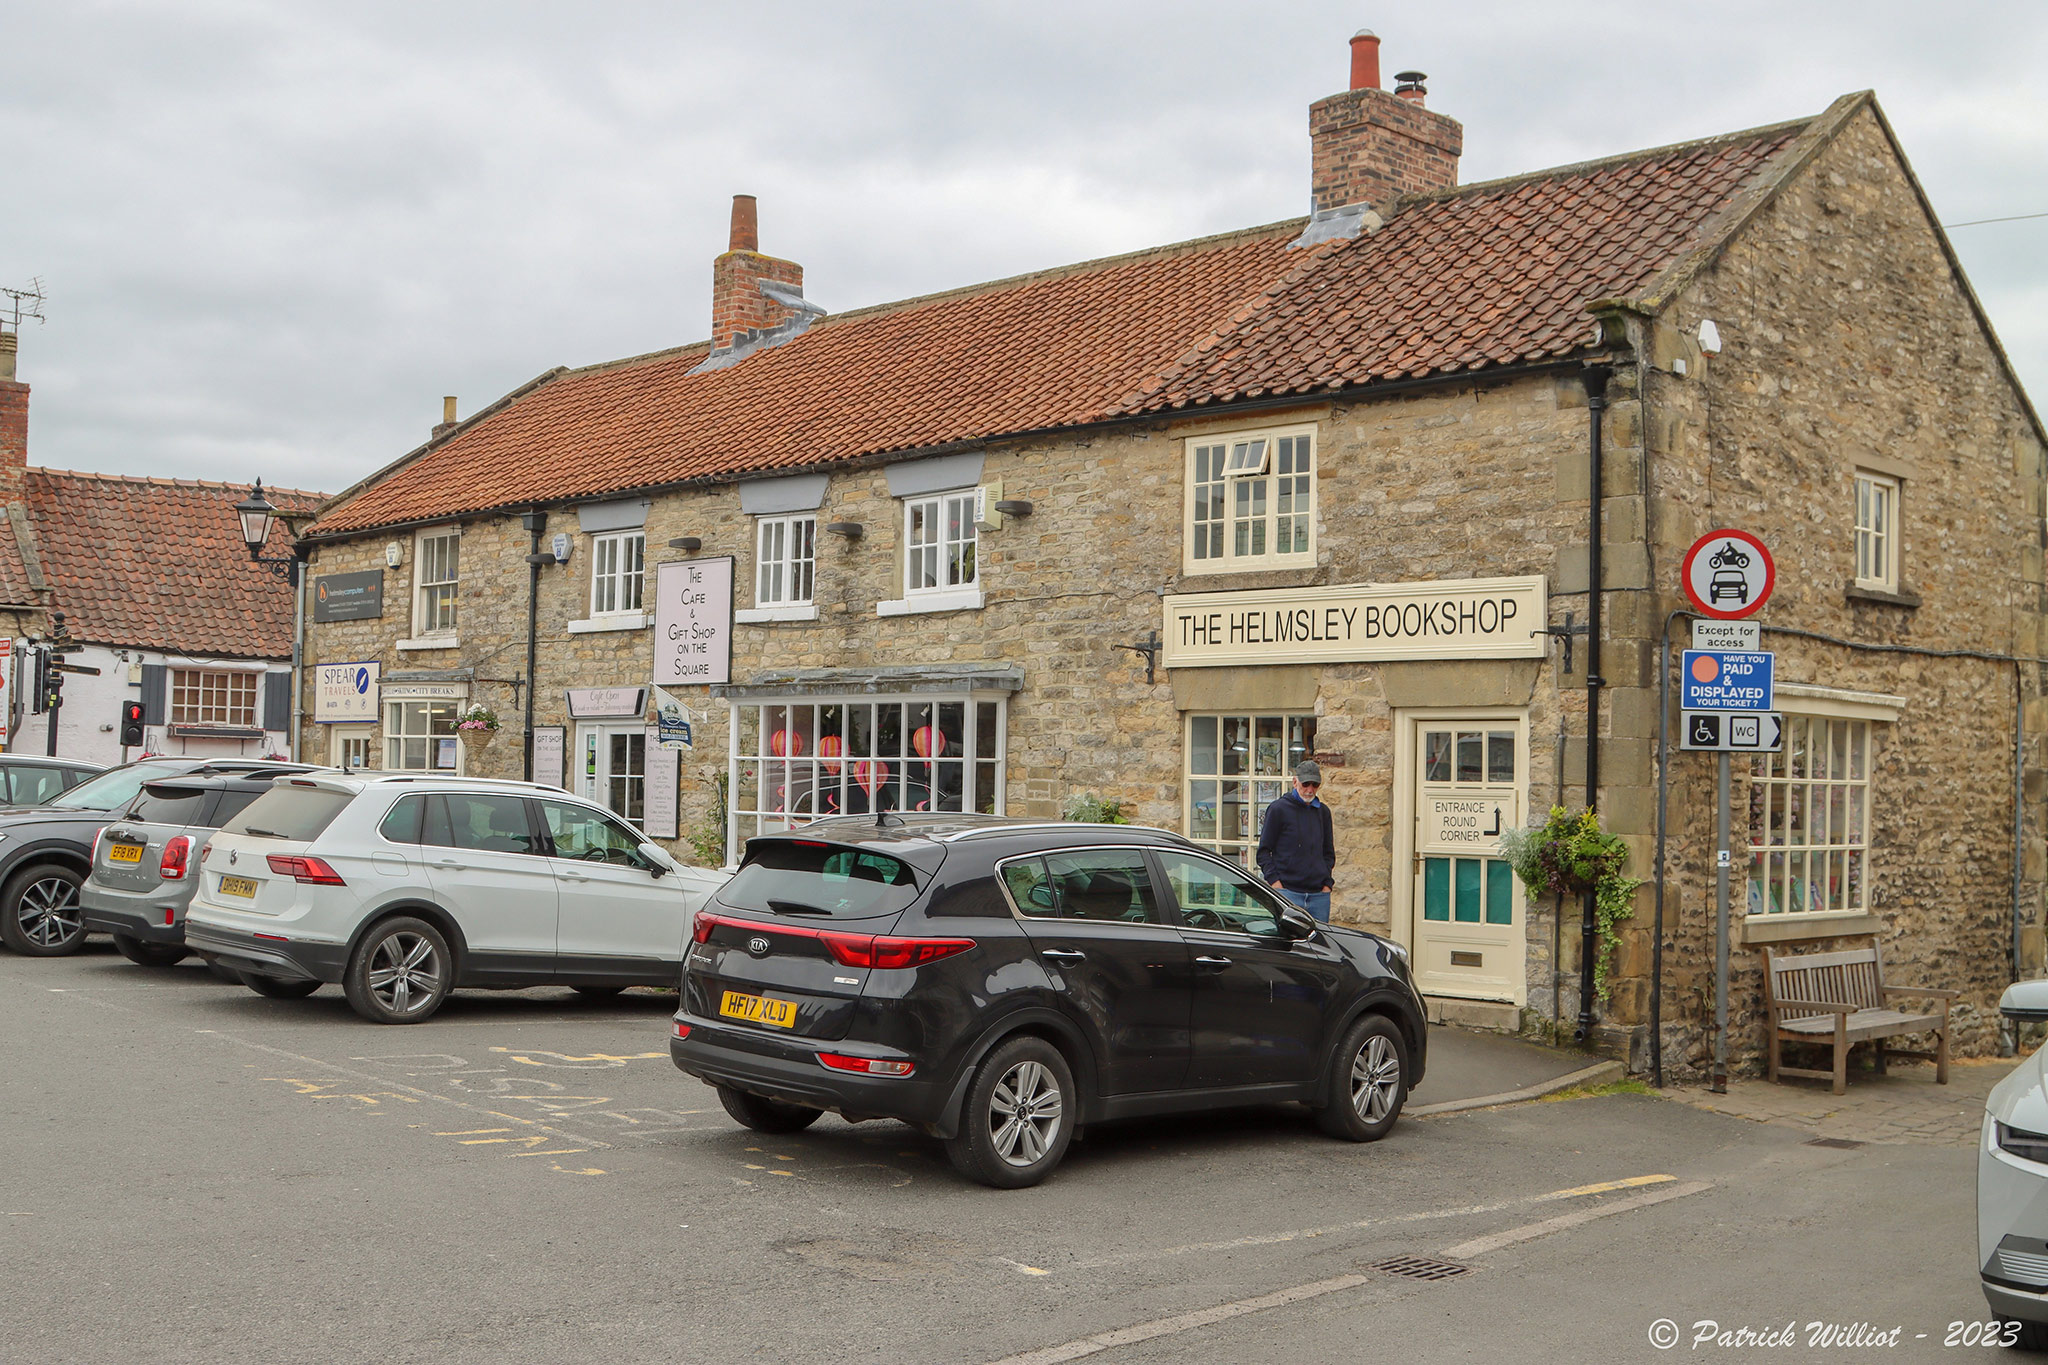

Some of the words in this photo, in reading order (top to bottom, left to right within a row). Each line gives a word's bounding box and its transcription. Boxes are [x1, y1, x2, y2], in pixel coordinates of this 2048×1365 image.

[688, 567, 702, 583] THE
[681, 588, 706, 605] CAFE
[689, 608, 695, 619] &
[1178, 612, 1222, 646] THE
[1229, 606, 1358, 644] HELMSLEY
[1365, 598, 1518, 640] BOOKSHOP
[668, 623, 688, 641] GIFT
[691, 622, 716, 640] SHOP
[1697, 625, 1734, 637] Except
[1739, 625, 1754, 636] for
[677, 644, 689, 655] ON
[692, 642, 707, 653] THE
[1707, 639, 1744, 648] access
[1723, 655, 1745, 663] HAVE
[1747, 655, 1765, 664] YOU
[674, 658, 709, 676] SQUARE
[1723, 663, 1753, 675] PAID
[324, 667, 356, 685] SPEAR
[1723, 675, 1732, 686] &
[324, 686, 356, 696] TRAVELS
[430, 687, 455, 695] BREAKS
[1690, 685, 1764, 699] DISPLAYED
[1696, 698, 1720, 706] YOUR
[1722, 699, 1751, 707] TICKET
[1735, 726, 1755, 737] WC
[1435, 802, 1485, 813] ENTRANCE
[1443, 816, 1476, 827] ROUND
[1440, 830, 1480, 841] CORNER
[750, 940, 764, 950] KIA
[727, 994, 757, 1015] HF17
[759, 999, 788, 1021] XLD
